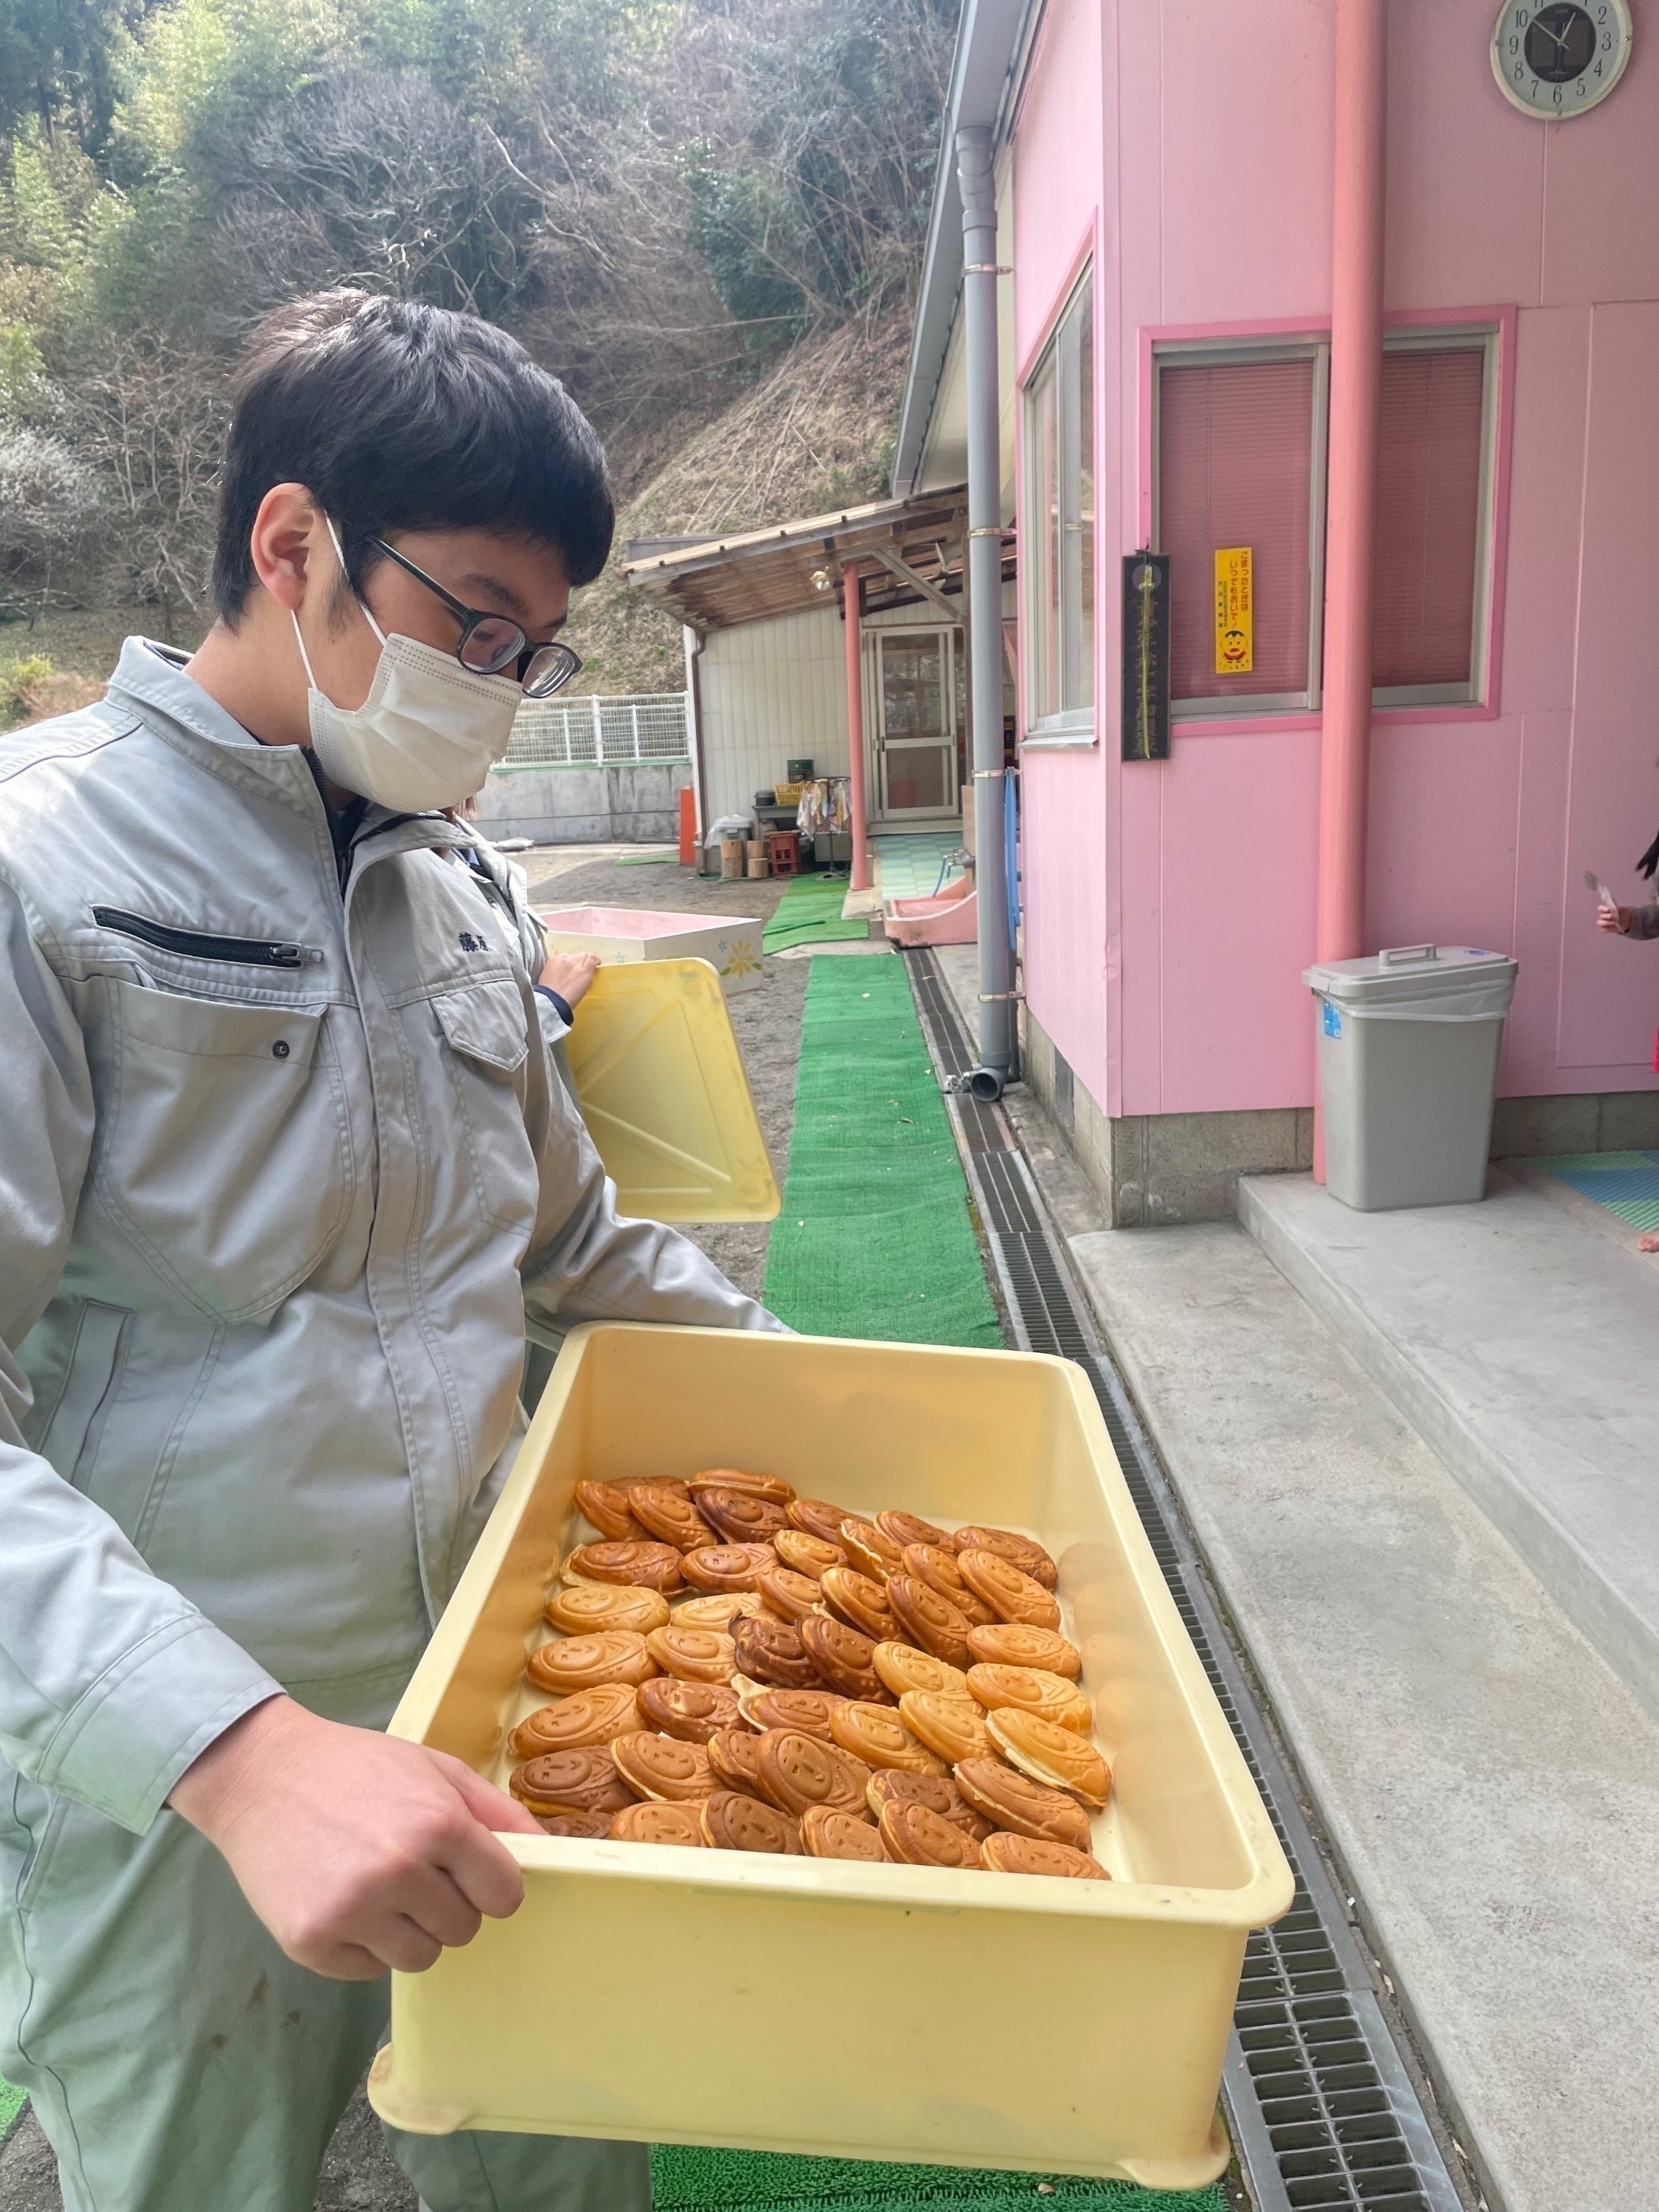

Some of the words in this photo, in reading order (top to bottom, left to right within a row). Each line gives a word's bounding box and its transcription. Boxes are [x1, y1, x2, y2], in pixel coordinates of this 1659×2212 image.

[1515, 9, 1528, 27] 10
[1598, 6, 1607, 24] 2
[1509, 35, 1519, 55] 9
[1601, 32, 1611, 51] 3
[1514, 61, 1524, 80] 8
[1593, 58, 1603, 77] 4
[1531, 80, 1539, 98] 7
[1553, 85, 1562, 104] 6
[1576, 78, 1585, 97] 5
